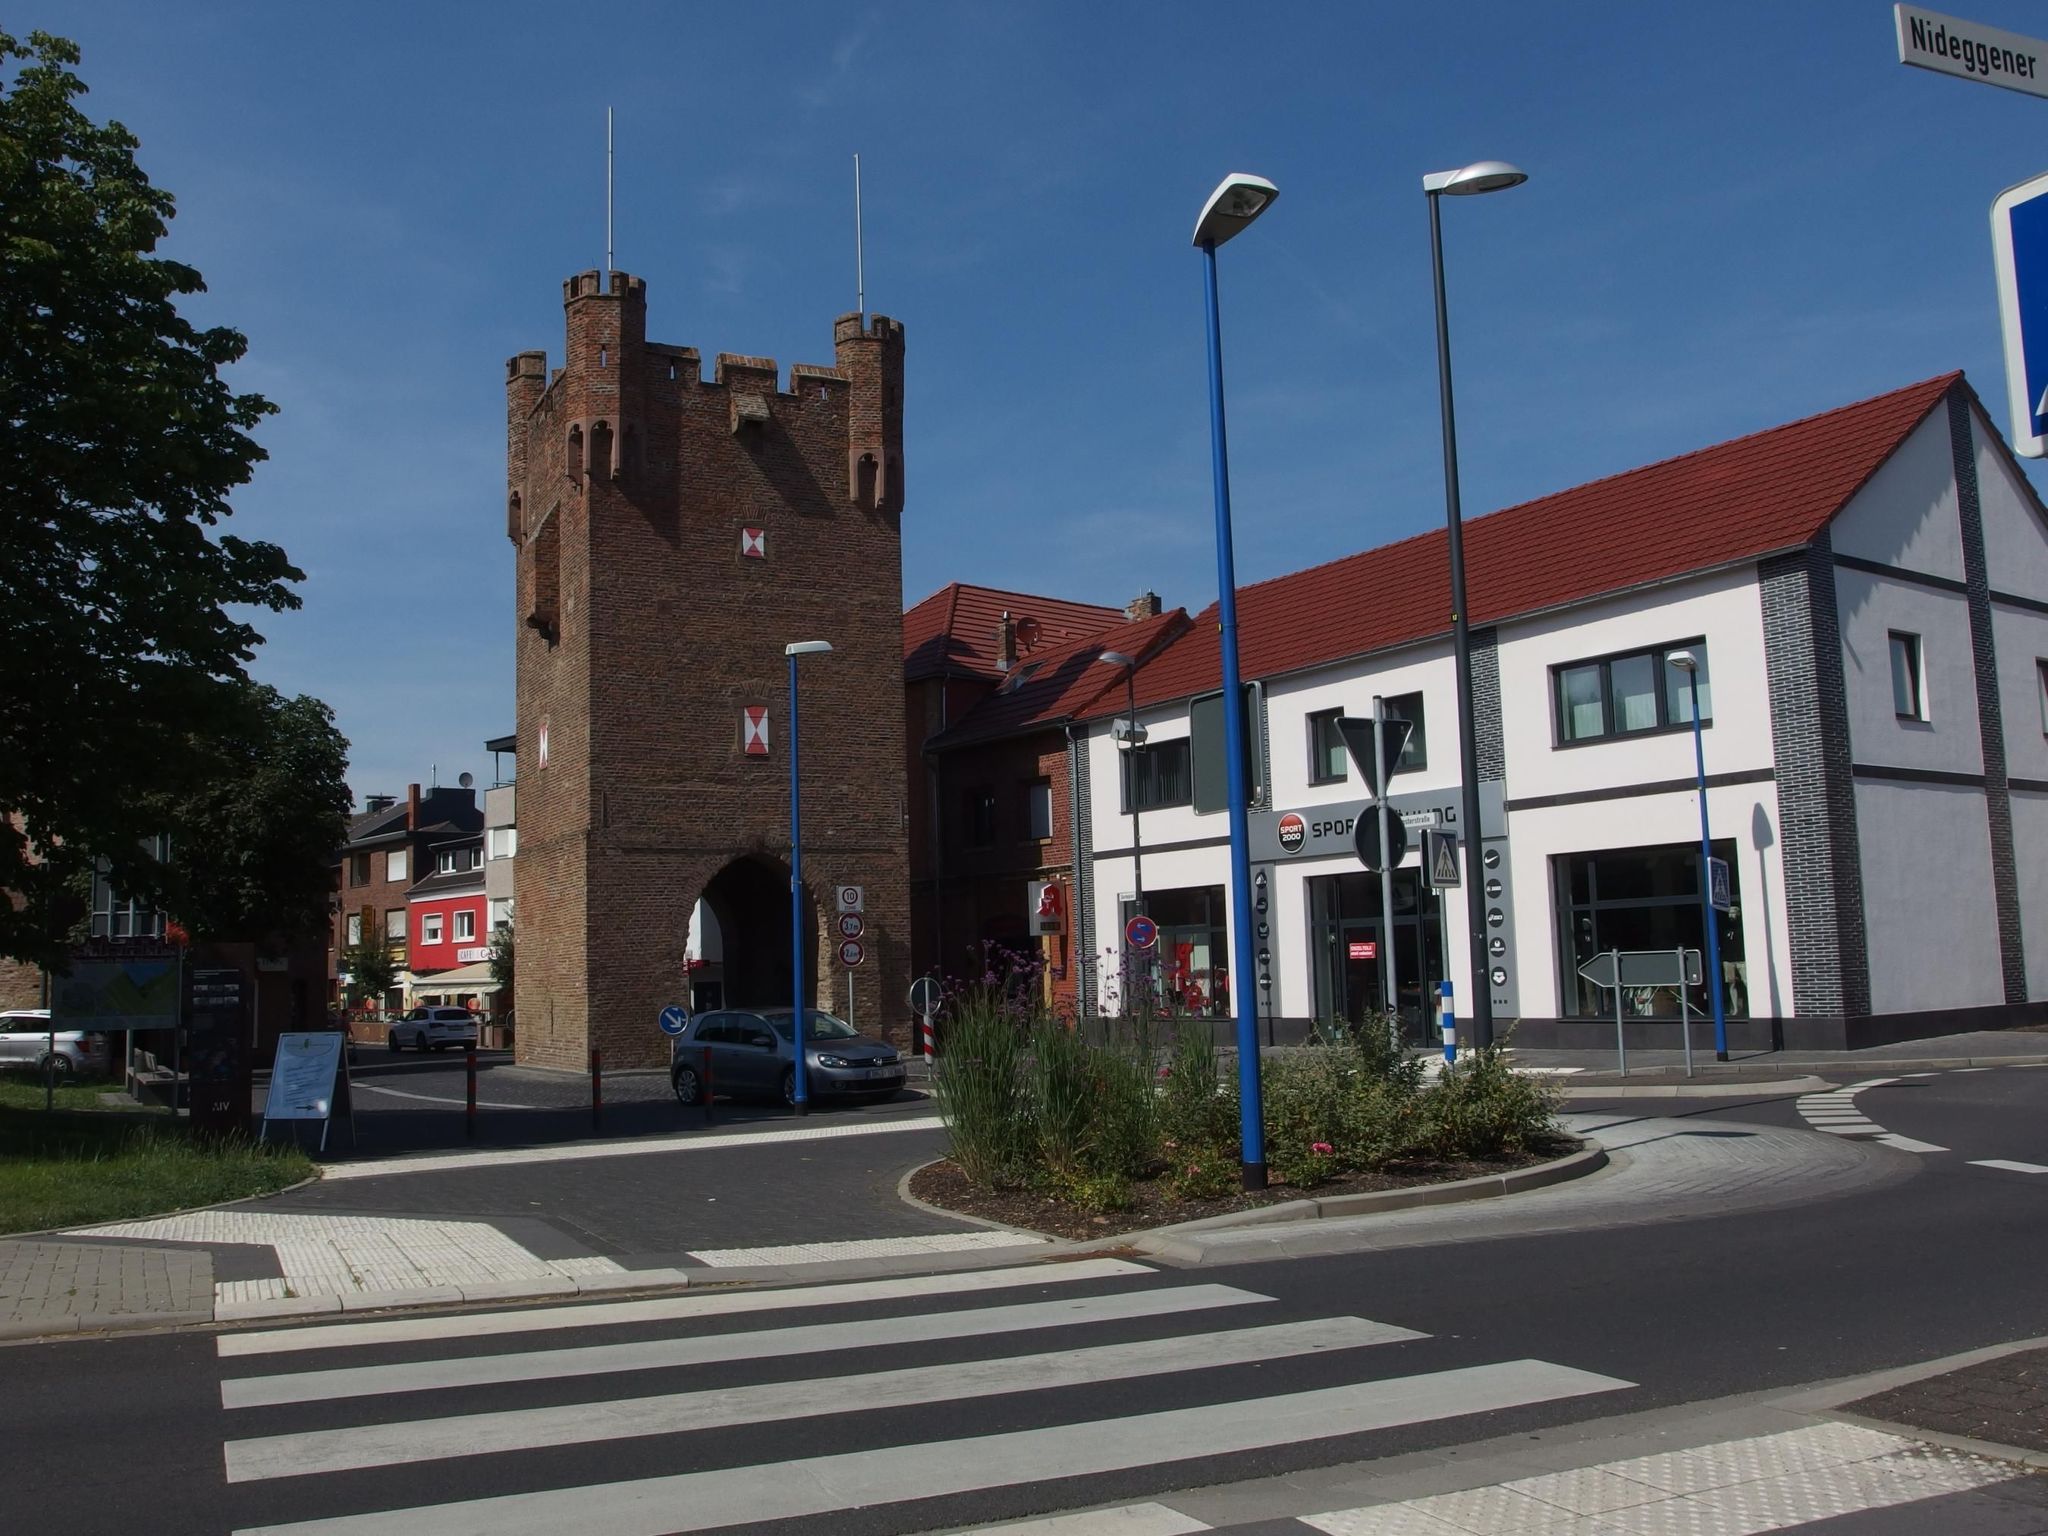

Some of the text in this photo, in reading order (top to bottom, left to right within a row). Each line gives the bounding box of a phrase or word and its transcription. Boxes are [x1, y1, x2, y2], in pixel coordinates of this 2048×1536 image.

[1910, 16, 2036, 79] Nideggener
[1401, 816, 1430, 825] sterstraße
[1280, 824, 1302, 834] SPORT
[1312, 818, 1356, 837] SPOR
[1282, 833, 1301, 841] 2000
[846, 892, 855, 900] 10
